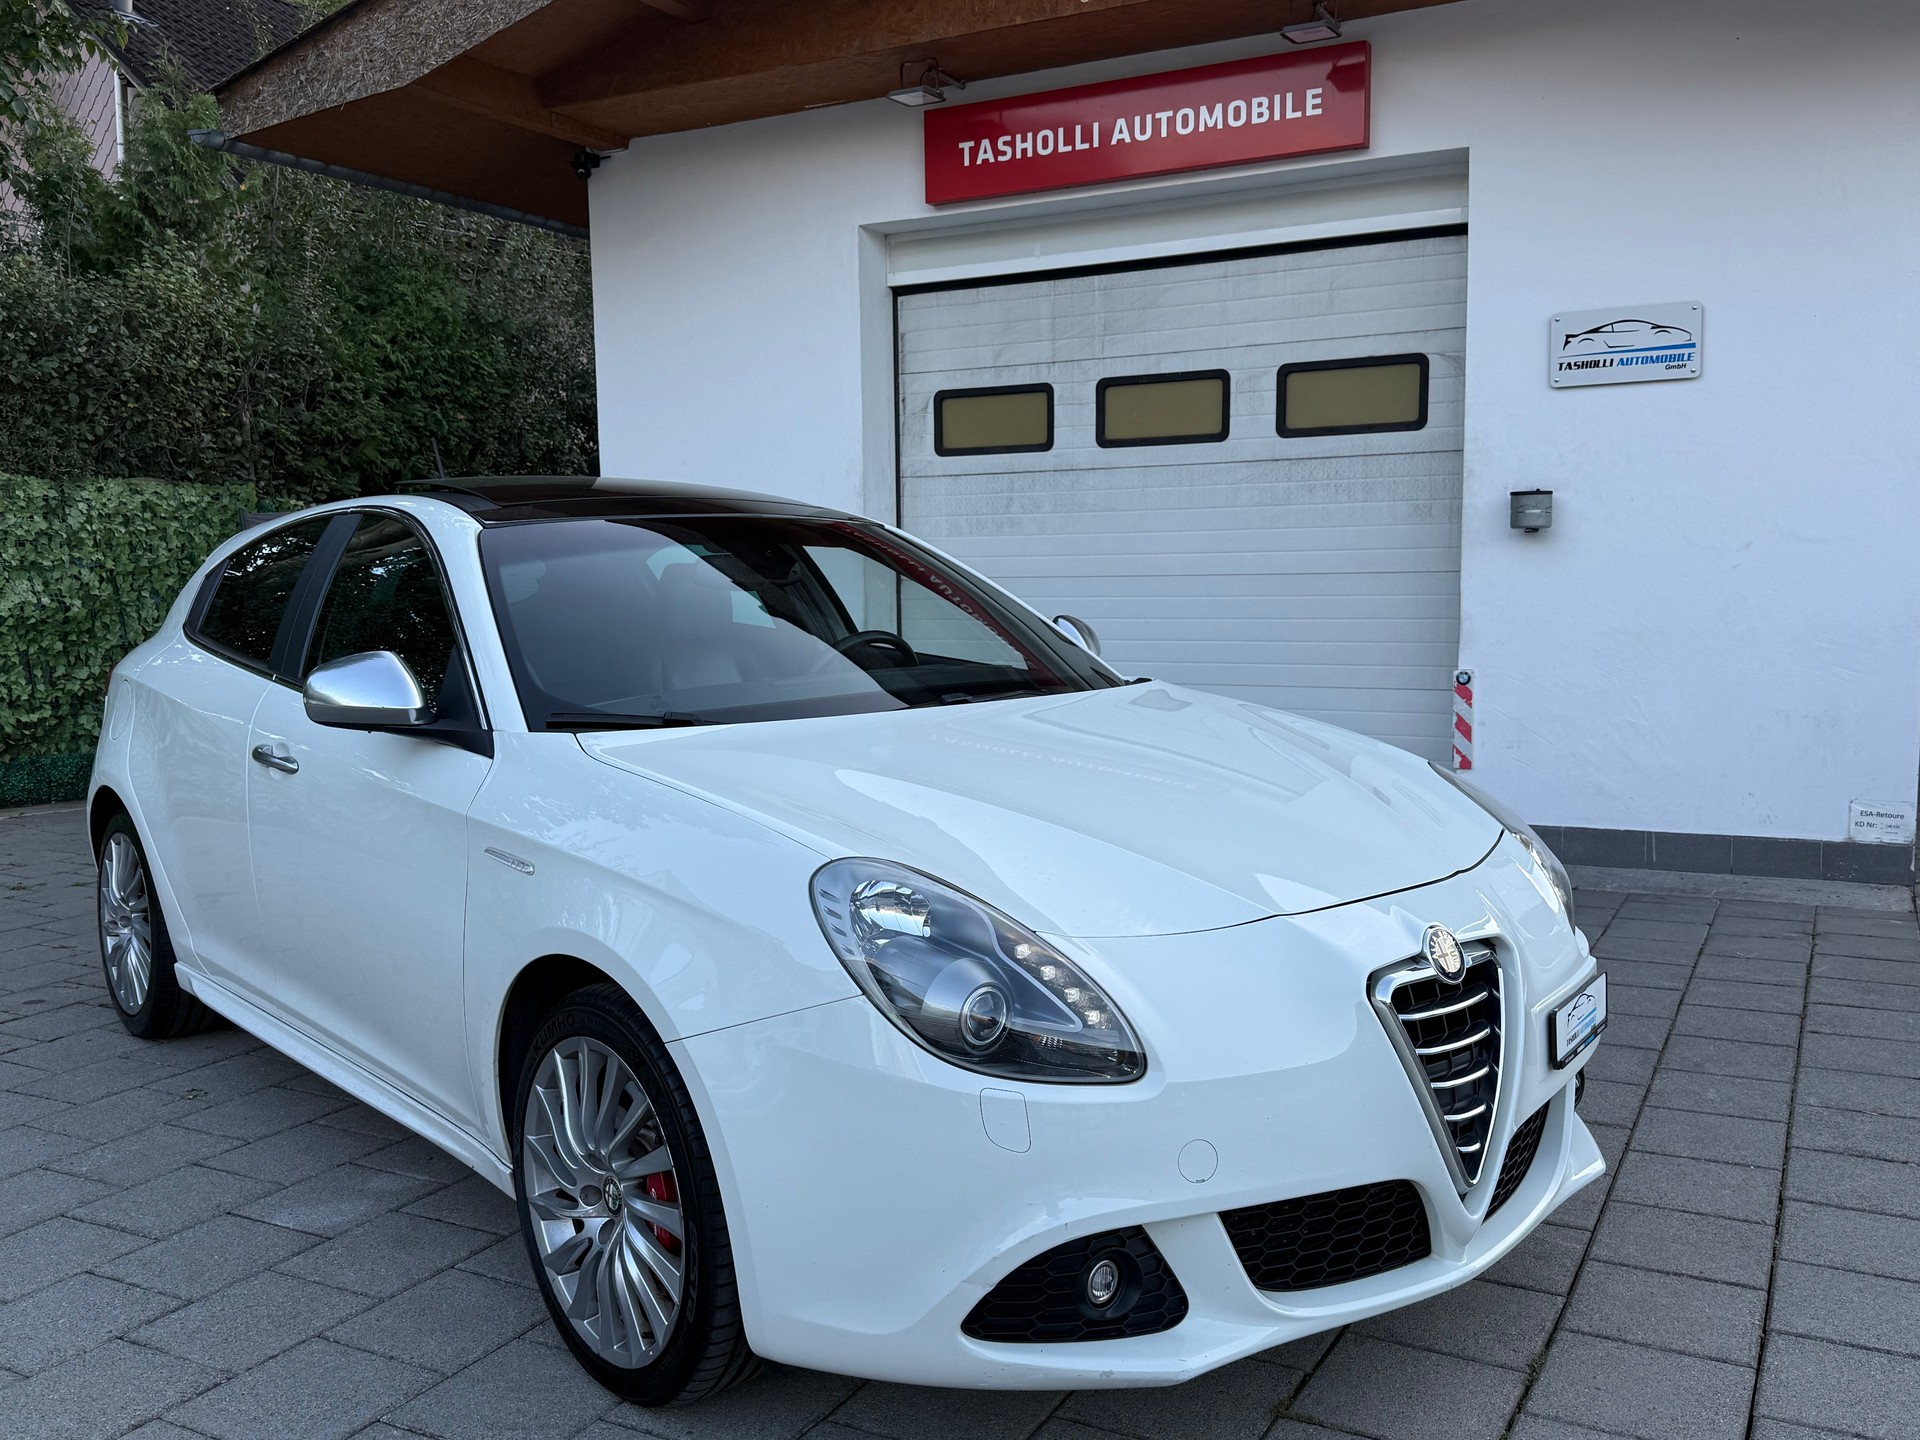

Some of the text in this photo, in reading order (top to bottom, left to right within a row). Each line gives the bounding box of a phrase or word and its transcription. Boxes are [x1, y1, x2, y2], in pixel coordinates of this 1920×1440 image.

[958, 87, 1324, 167] TASHOLLI AUTOMOBILE
[1557, 352, 1696, 371] TASHOLLI AUTOMOBILE
[1664, 363, 1687, 371] GmbH
[1860, 810, 1905, 820] ESA-Retoure
[533, 1013, 575, 1066] KUMHO
